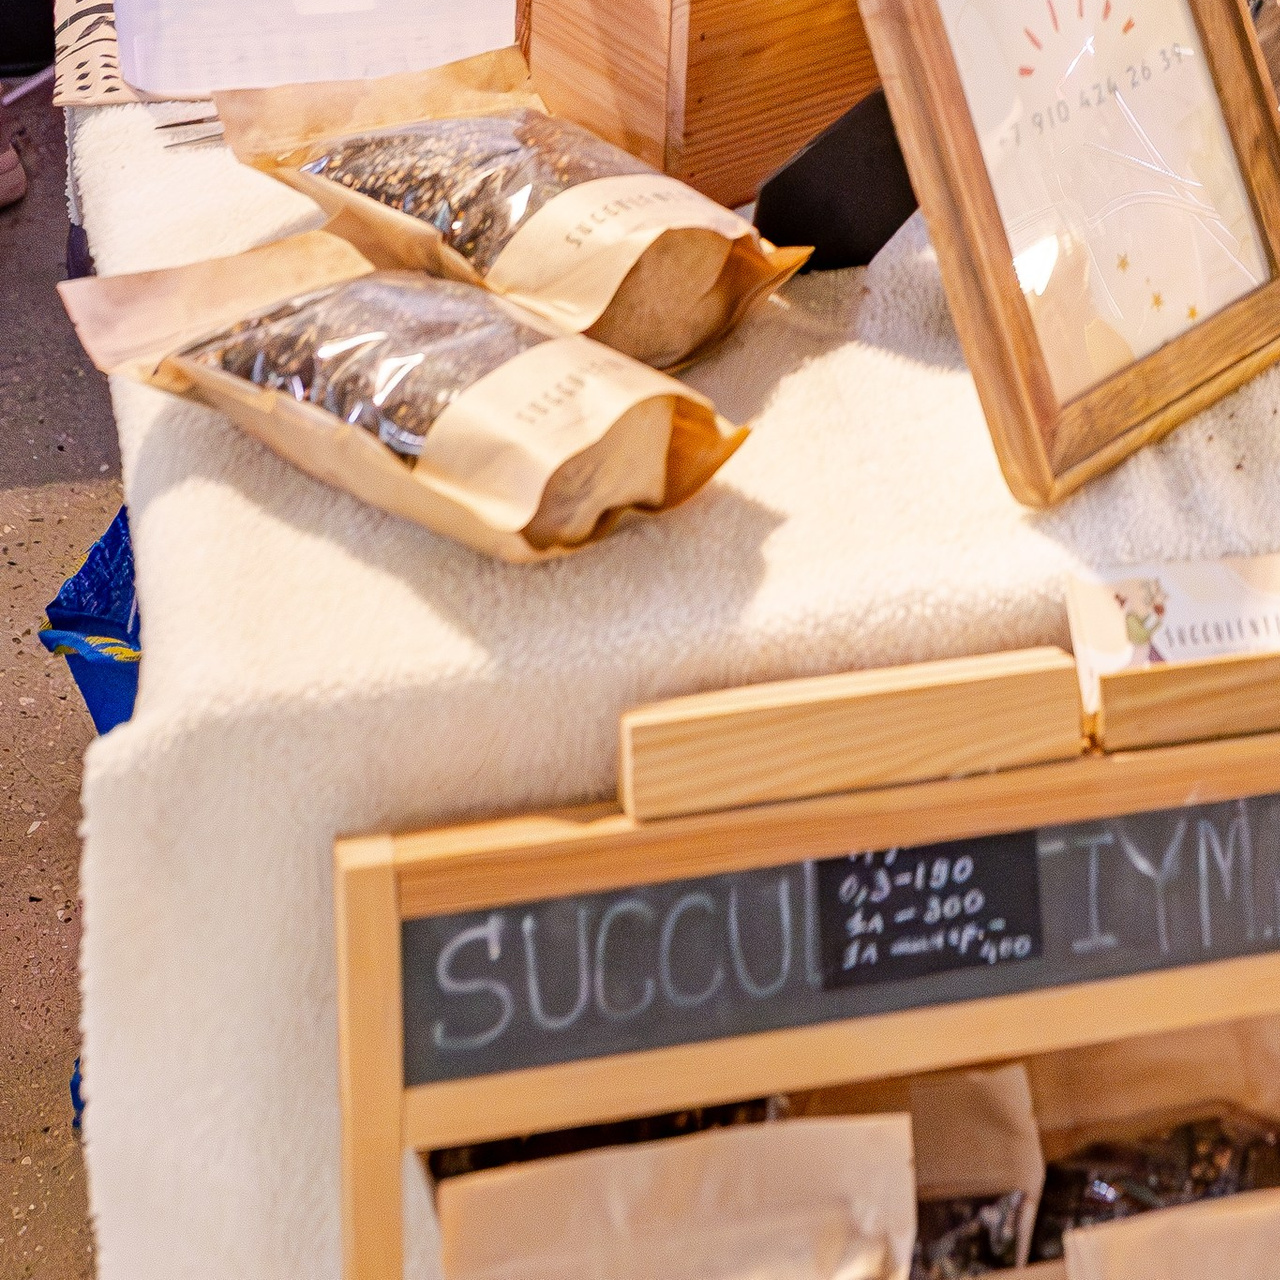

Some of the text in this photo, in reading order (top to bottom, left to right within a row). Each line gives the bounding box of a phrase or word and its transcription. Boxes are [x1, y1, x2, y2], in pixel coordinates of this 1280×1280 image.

[1030, 98, 1071, 136] 910
[1078, 77, 1120, 109] 424
[1125, 58, 1153, 90] 26
